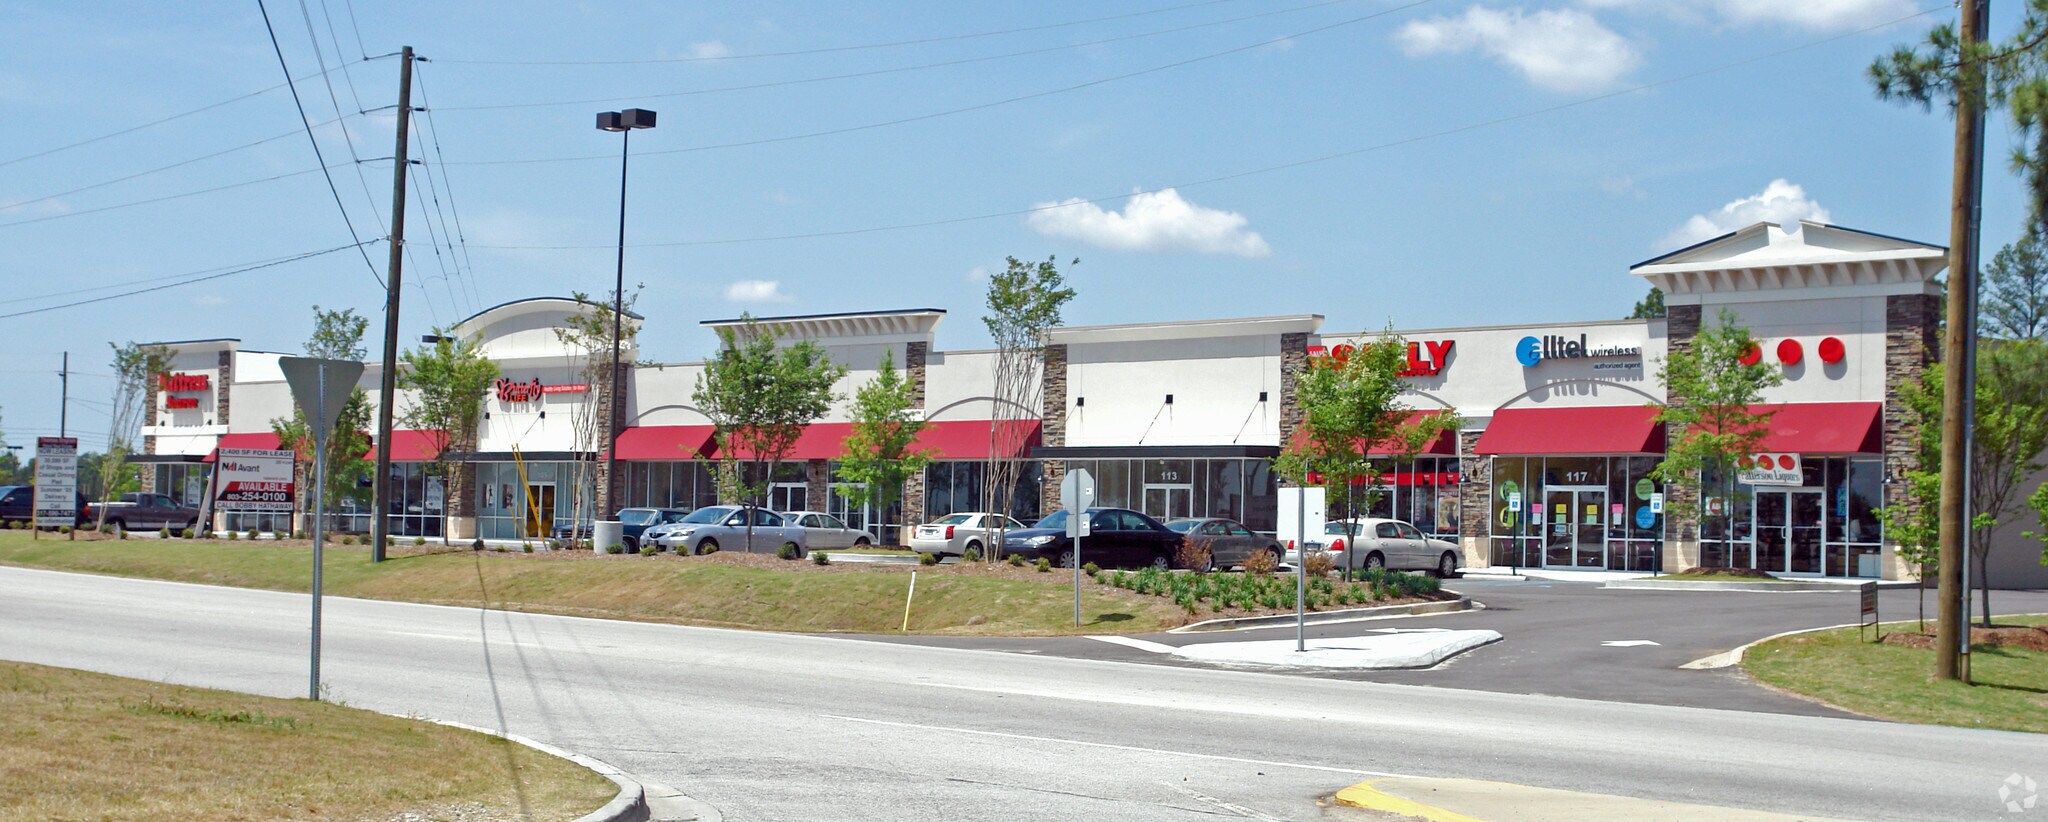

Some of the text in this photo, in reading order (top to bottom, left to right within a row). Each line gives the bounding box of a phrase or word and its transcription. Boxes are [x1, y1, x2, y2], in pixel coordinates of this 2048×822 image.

[1591, 345, 1638, 357] wireless
[1594, 362, 1641, 371] authorized agent
[496, 377, 542, 402] Butterfly
[509, 394, 528, 402] LIFE
[238, 463, 260, 473] Avant
[1161, 471, 1178, 480] 113
[1566, 471, 1588, 482] 117
[238, 482, 288, 492] AVAILABLE
[227, 492, 286, 501] 803-254-0100
